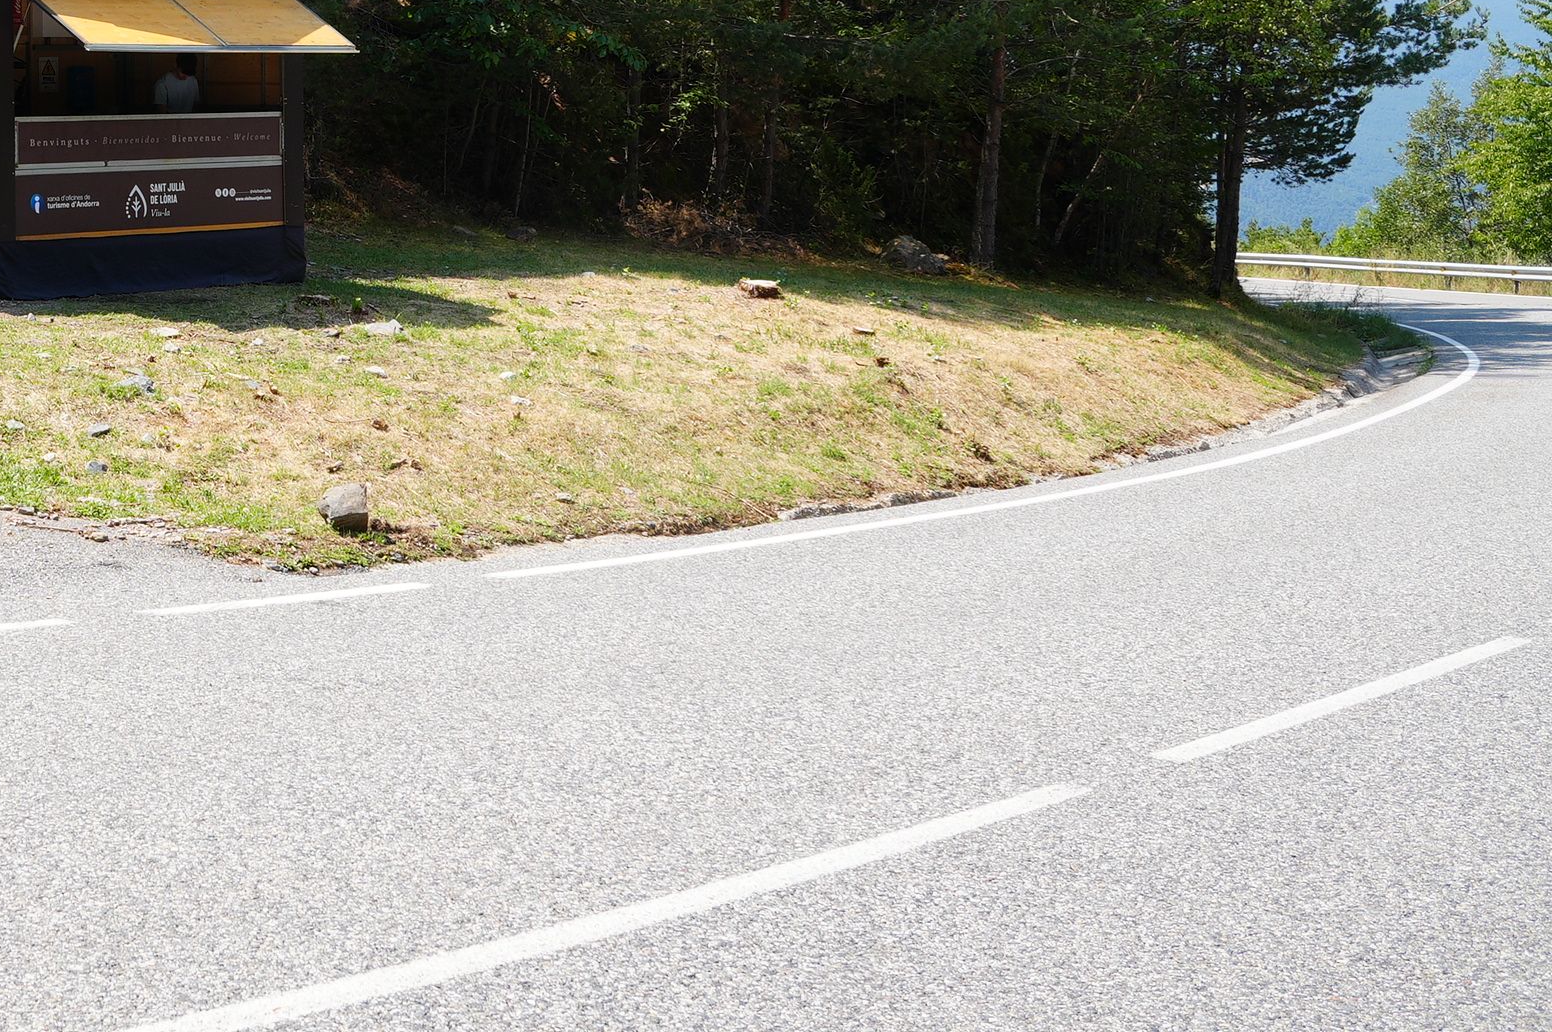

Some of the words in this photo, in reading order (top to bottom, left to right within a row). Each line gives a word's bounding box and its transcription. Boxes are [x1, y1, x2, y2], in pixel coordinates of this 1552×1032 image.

[30, 137, 90, 147] Benvinguts
[102, 135, 160, 145] Bienvenidos
[171, 134, 222, 143] Bienvenue
[233, 132, 271, 141] Welcome
[149, 183, 166, 193] SANT
[167, 180, 186, 192] JULIÀ
[47, 201, 70, 209] turisme
[71, 200, 100, 208] d'Andorra
[150, 195, 159, 205] DE
[159, 192, 178, 204] LÒRIA
